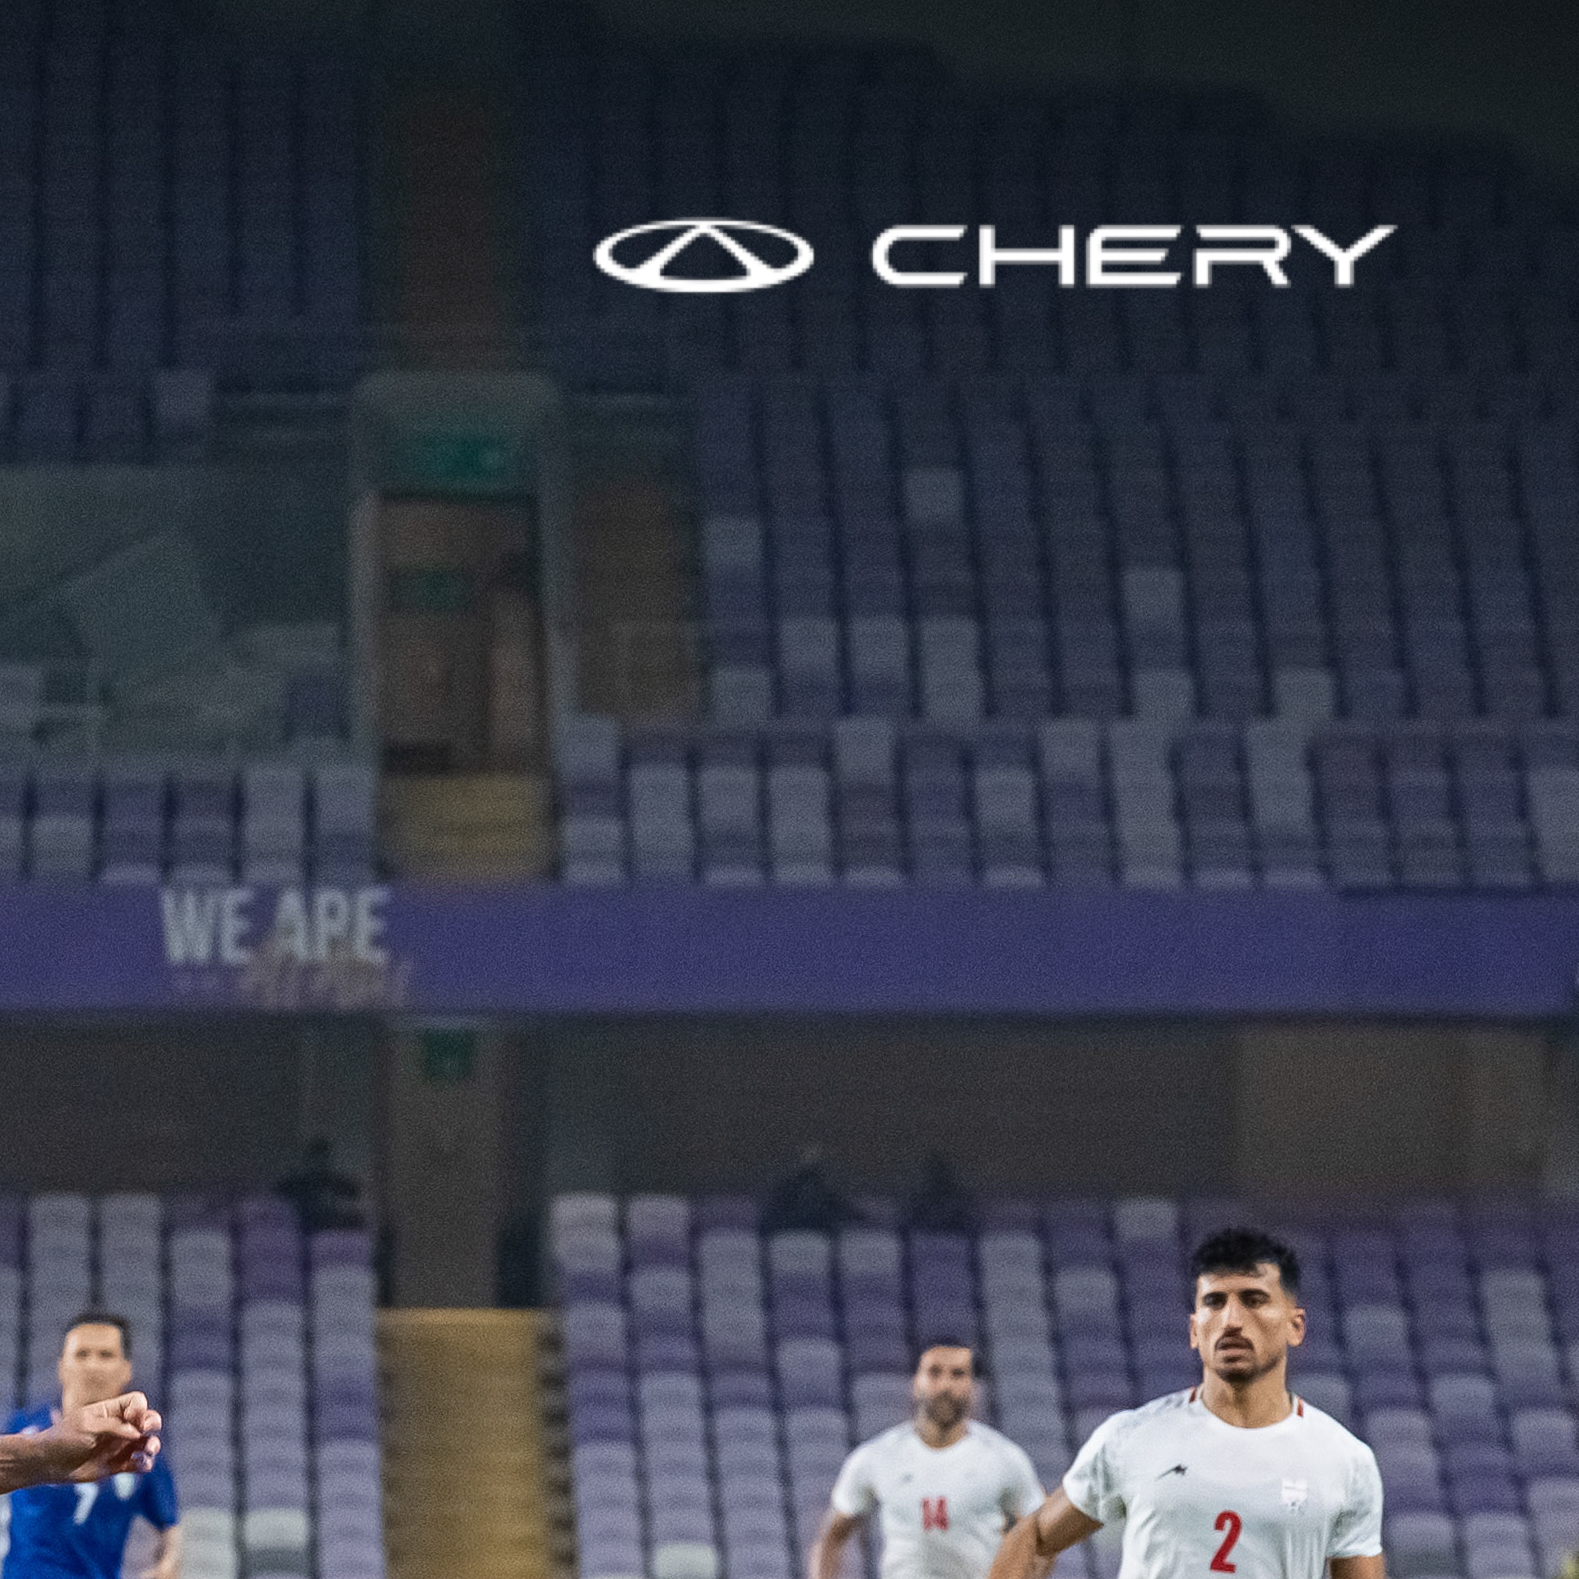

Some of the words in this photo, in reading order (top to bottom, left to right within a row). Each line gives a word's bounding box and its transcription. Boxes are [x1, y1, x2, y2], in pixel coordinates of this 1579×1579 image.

[161, 886, 253, 965] WE
[271, 886, 393, 965] ARE
[73, 1483, 99, 1525] 7
[921, 1496, 950, 1532] 14
[1210, 1510, 1243, 1574] 2
